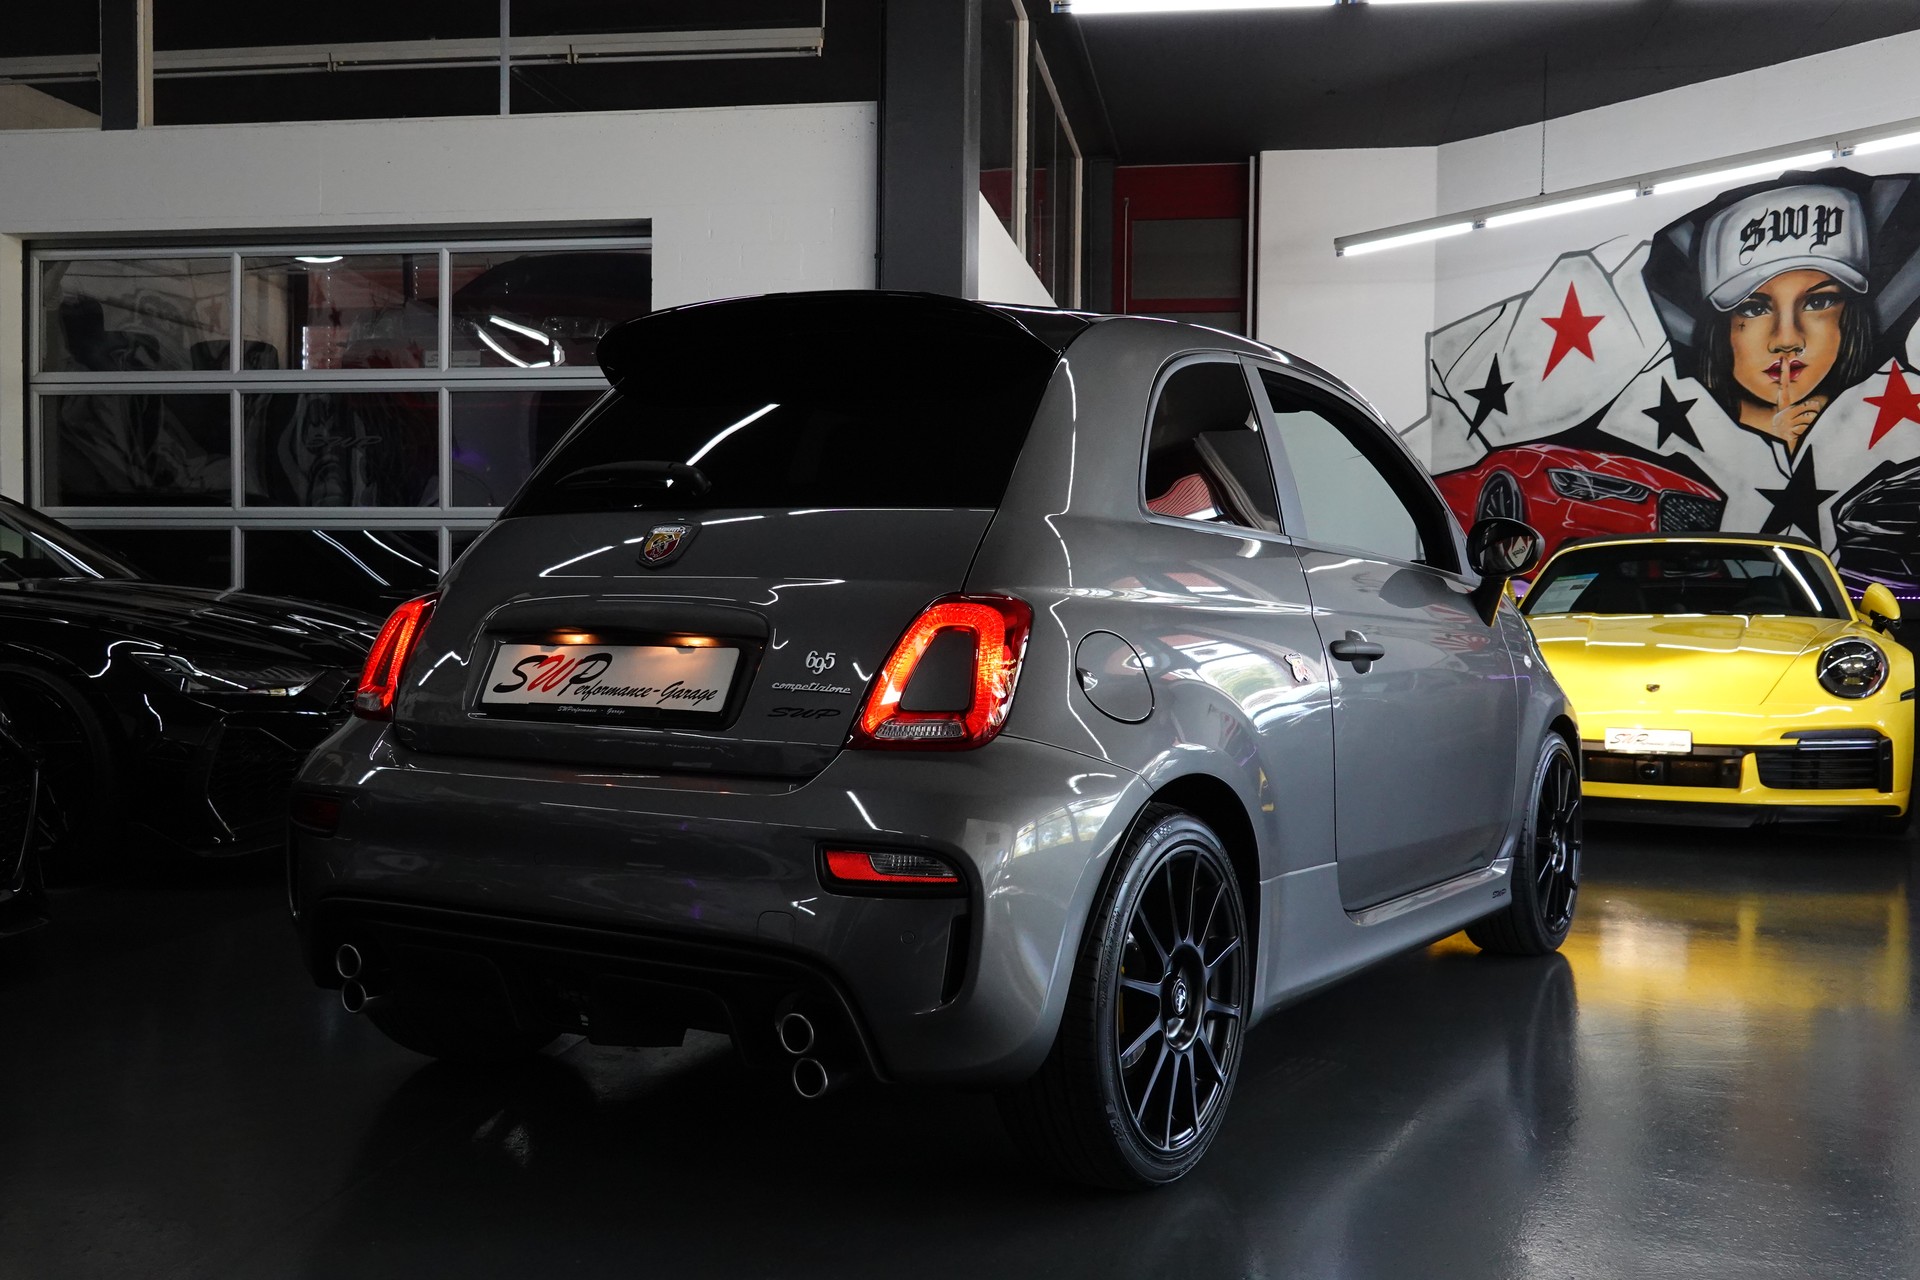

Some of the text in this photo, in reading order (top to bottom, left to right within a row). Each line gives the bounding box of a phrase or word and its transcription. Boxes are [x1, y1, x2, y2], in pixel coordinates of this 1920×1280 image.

[805, 650, 836, 675] 695
[771, 682, 851, 694] competizione
[767, 707, 841, 719] SWP
